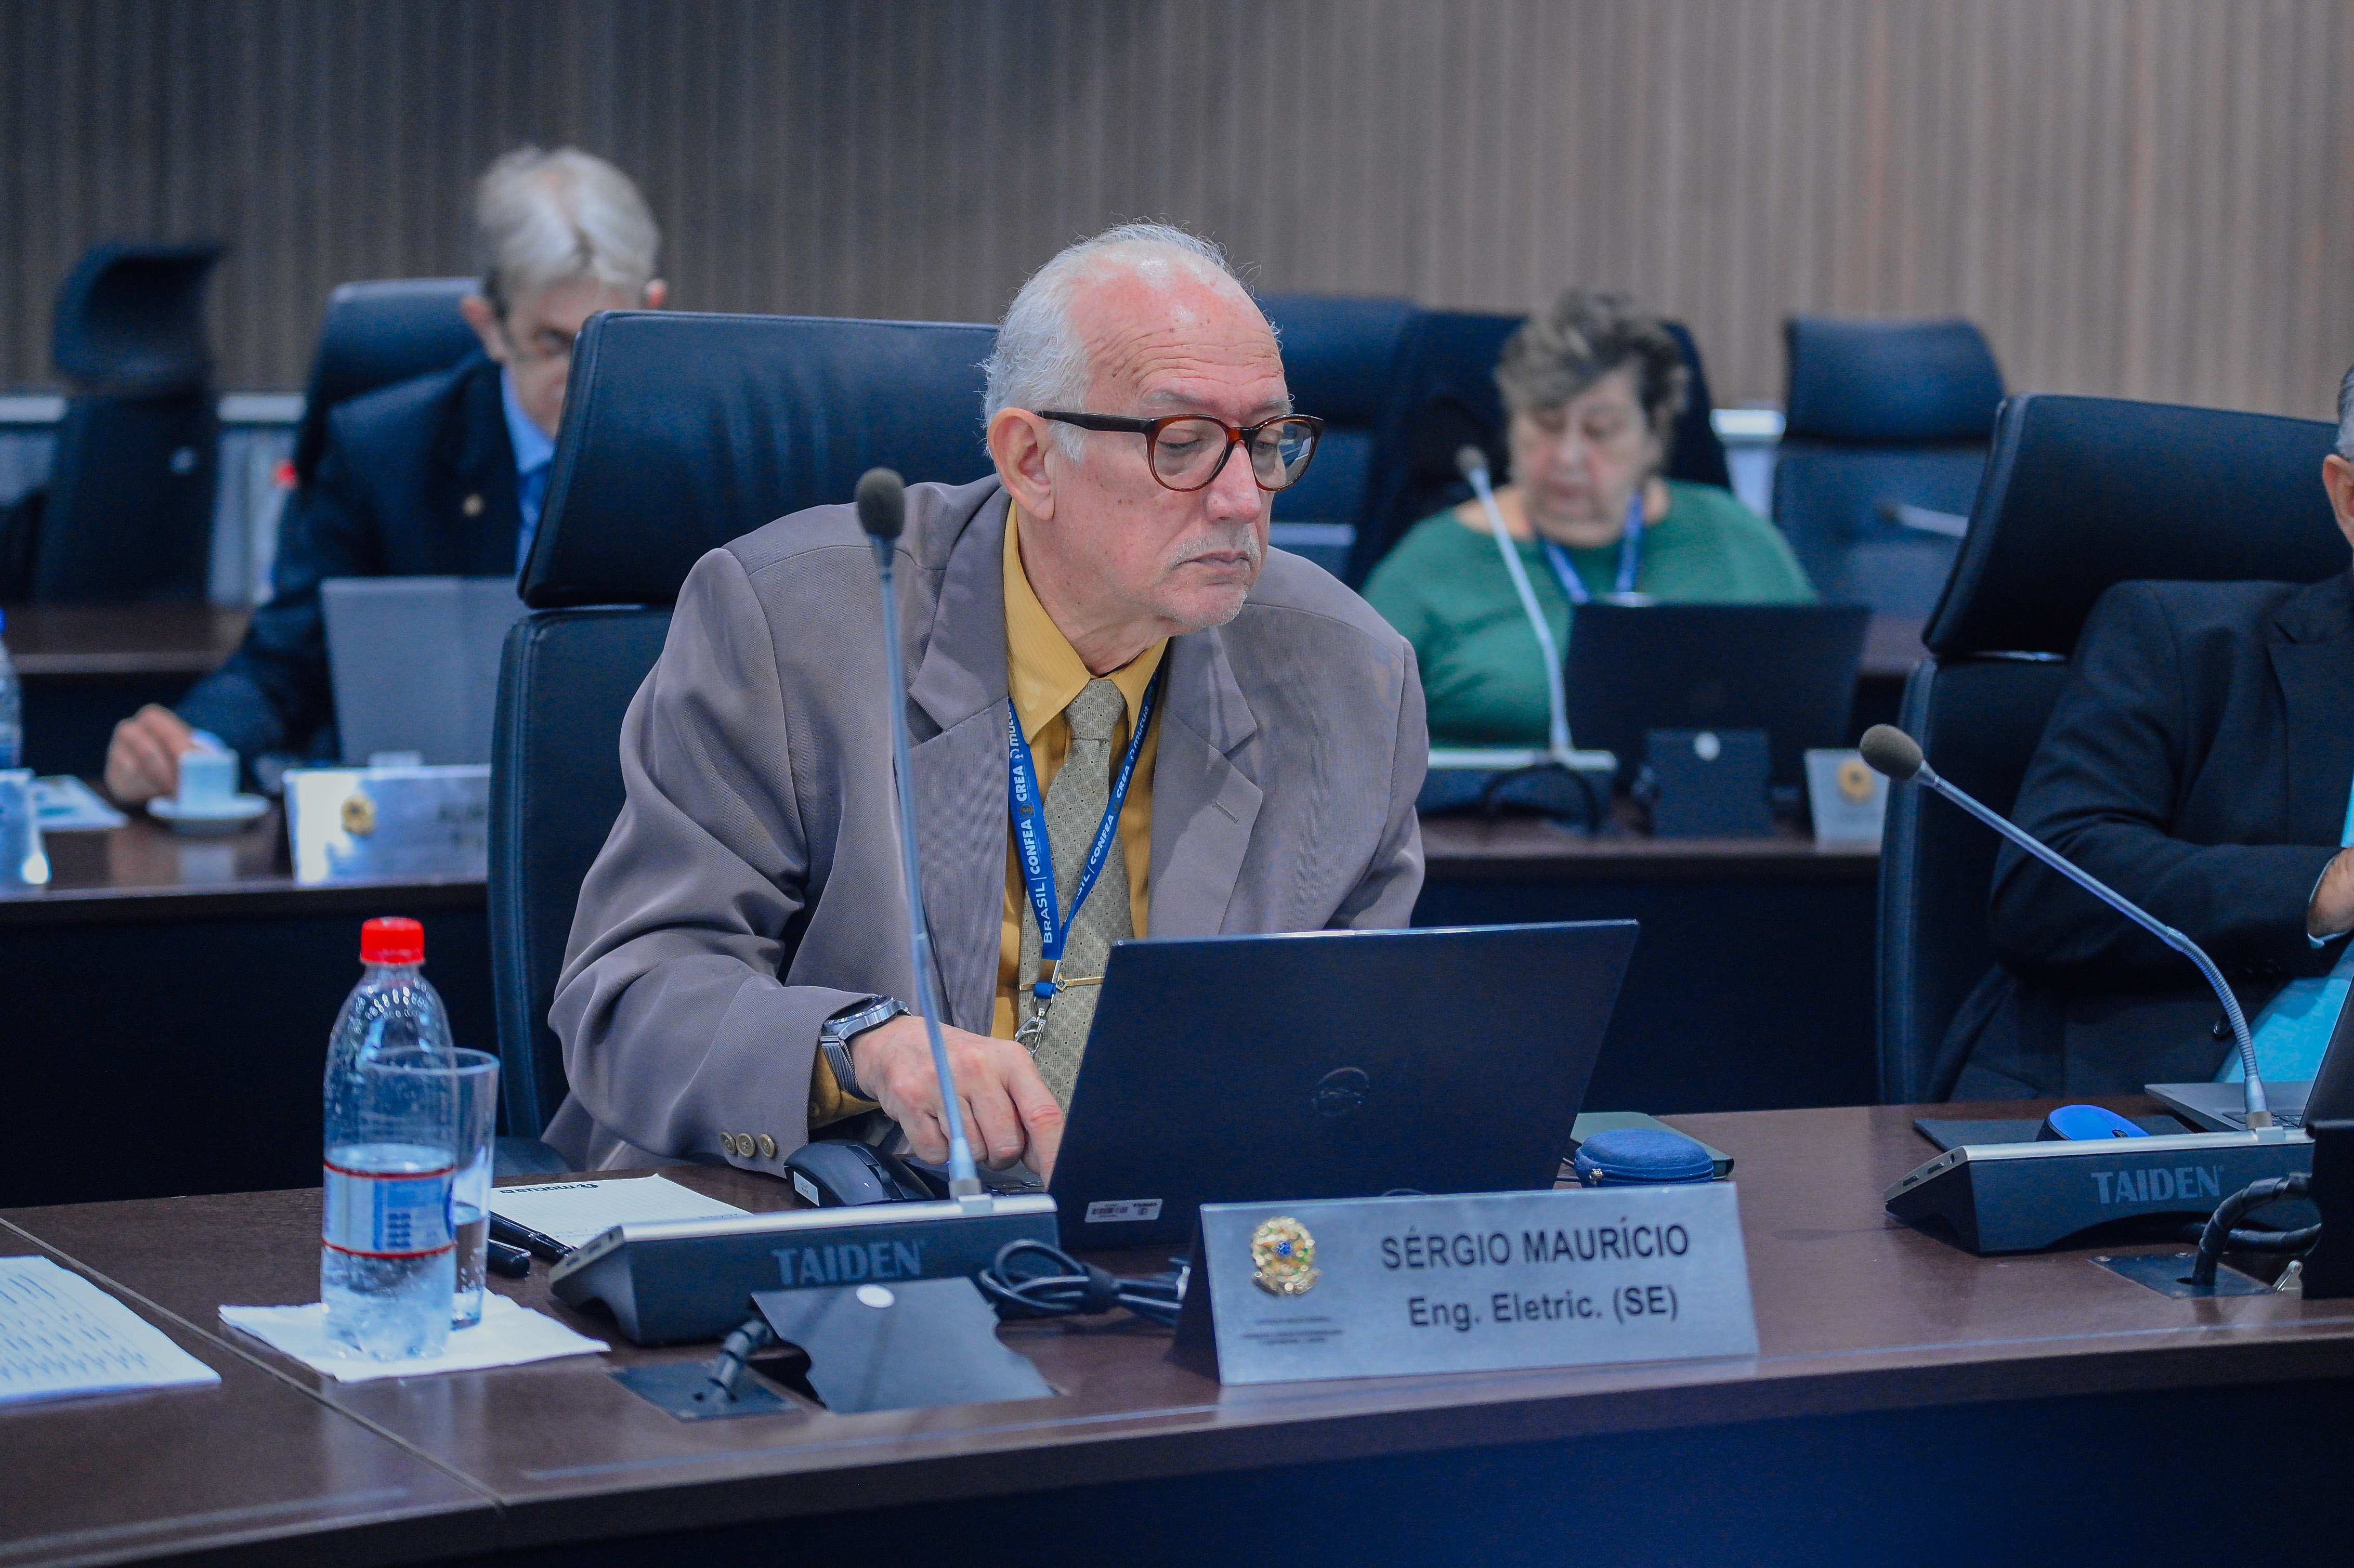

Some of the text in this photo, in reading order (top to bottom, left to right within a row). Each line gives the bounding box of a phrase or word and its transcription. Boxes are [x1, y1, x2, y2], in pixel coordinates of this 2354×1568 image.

[1013, 765, 1028, 802] CREA
[1090, 815, 1114, 865] CONFEA
[1116, 765, 1130, 799] CREA
[1021, 819, 1040, 874] CONFEA
[1035, 882, 1053, 944] BRASIL
[2090, 1165, 2220, 1205] TAIDEN
[770, 1240, 923, 1286] TAIDEN
[1380, 1214, 1689, 1269] SÉRGIO MAURÍCIO
[1408, 1284, 1679, 1333] Eng. Eletric. (SE)
